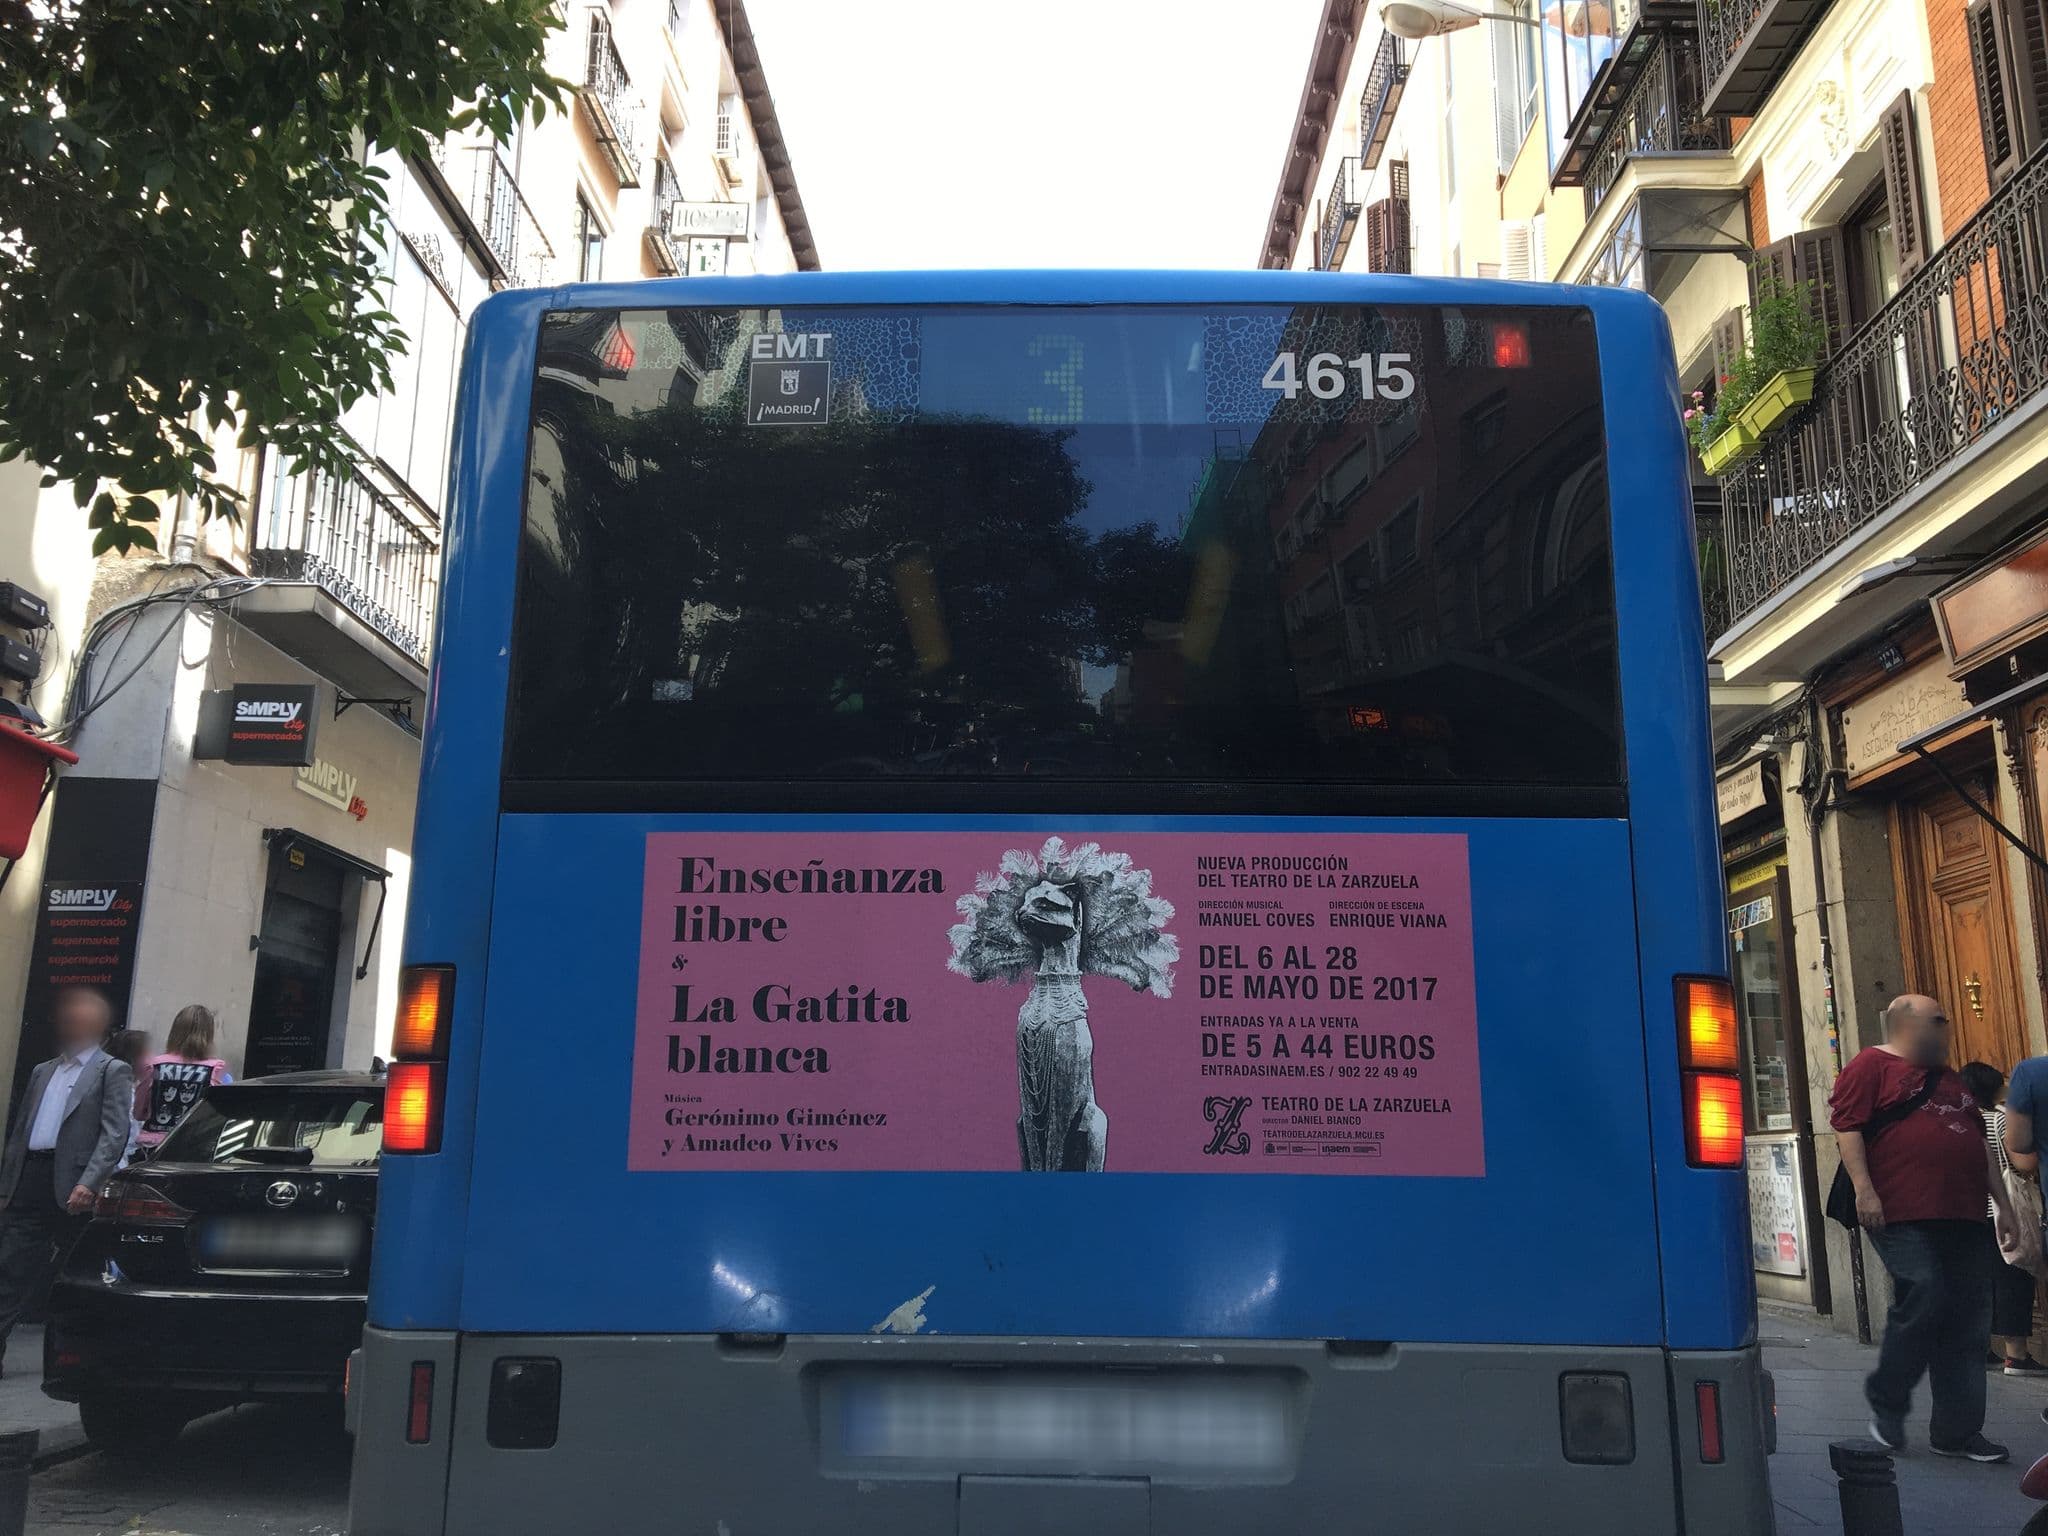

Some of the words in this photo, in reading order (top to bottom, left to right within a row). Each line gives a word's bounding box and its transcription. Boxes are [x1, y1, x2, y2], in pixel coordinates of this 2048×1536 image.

[751, 333, 832, 359] EMT
[1028, 334, 1085, 424] 3
[1261, 352, 1416, 400] 4615
[757, 397, 820, 421] ¡MADRID!
[232, 732, 304, 741] supermercados
[1197, 856, 1247, 871] NUEVA
[1251, 853, 1348, 871] PRODUCCIÓN
[675, 856, 947, 894] Enseñanza
[1198, 873, 1226, 888] DEL
[1230, 873, 1288, 888] TEATRO
[1293, 874, 1313, 888] DE
[1317, 874, 1337, 889] LA
[1341, 874, 1420, 889] ZARZUELA
[1198, 899, 1244, 910] DIRECCIÓN
[1246, 900, 1284, 910] MUSICAL
[1328, 899, 1375, 910] DIRECCIÓN
[1377, 901, 1389, 910] DE
[1391, 901, 1425, 911] ESCENA
[50, 917, 128, 928] supermercado
[672, 905, 788, 943] libre
[1199, 912, 1261, 927] MANUEL
[1266, 912, 1315, 928] COVES
[1329, 913, 1395, 929] ENRIQUE
[1399, 913, 1447, 928] VIANA
[1199, 944, 1249, 969] DEL
[1257, 945, 1274, 970] 6
[1282, 945, 1317, 970] AL
[1325, 946, 1358, 971] 28
[1199, 974, 1234, 999] DE
[1243, 974, 1319, 1000] MAYO
[1329, 975, 1364, 1000] DE
[1373, 976, 1438, 1001] 2017
[668, 984, 738, 1023] La
[752, 984, 912, 1023] Gatita
[1200, 1015, 1265, 1028] ENTRADAS
[1268, 1015, 1284, 1028] YA
[1287, 1016, 1297, 1028] A
[1300, 1016, 1316, 1028] LA
[1319, 1016, 1359, 1029] VENTA
[665, 1034, 832, 1074] blanca
[1201, 1032, 1236, 1058] DE
[1246, 1033, 1262, 1059] 5
[1272, 1033, 1291, 1059] A
[1300, 1033, 1334, 1059] 44
[1344, 1034, 1435, 1061] EUROS
[159, 1064, 209, 1081] KISS
[1201, 1064, 1325, 1078] ENTRADASINAEM.ES
[1338, 1065, 1361, 1078] 902
[1364, 1066, 1380, 1078] 22
[1383, 1066, 1399, 1079] 49
[1402, 1066, 1418, 1079] 49
[1261, 1096, 1319, 1112] TEATRO
[1324, 1097, 1344, 1112] DE
[1349, 1097, 1368, 1112] LA
[1373, 1097, 1452, 1113] ZARZUELA
[665, 1108, 780, 1127] Gerónimo
[786, 1108, 887, 1126] Giménez
[1291, 1115, 1325, 1125] DANIEL
[1326, 1115, 1362, 1126] BIANCO
[1262, 1129, 1385, 1140] TEATRODELAZARZUELA.MCU.ES
[661, 1139, 673, 1157] y
[680, 1133, 772, 1152] Amadeo
[779, 1133, 838, 1152] Vives
[121, 1234, 164, 1244] LEXUS
